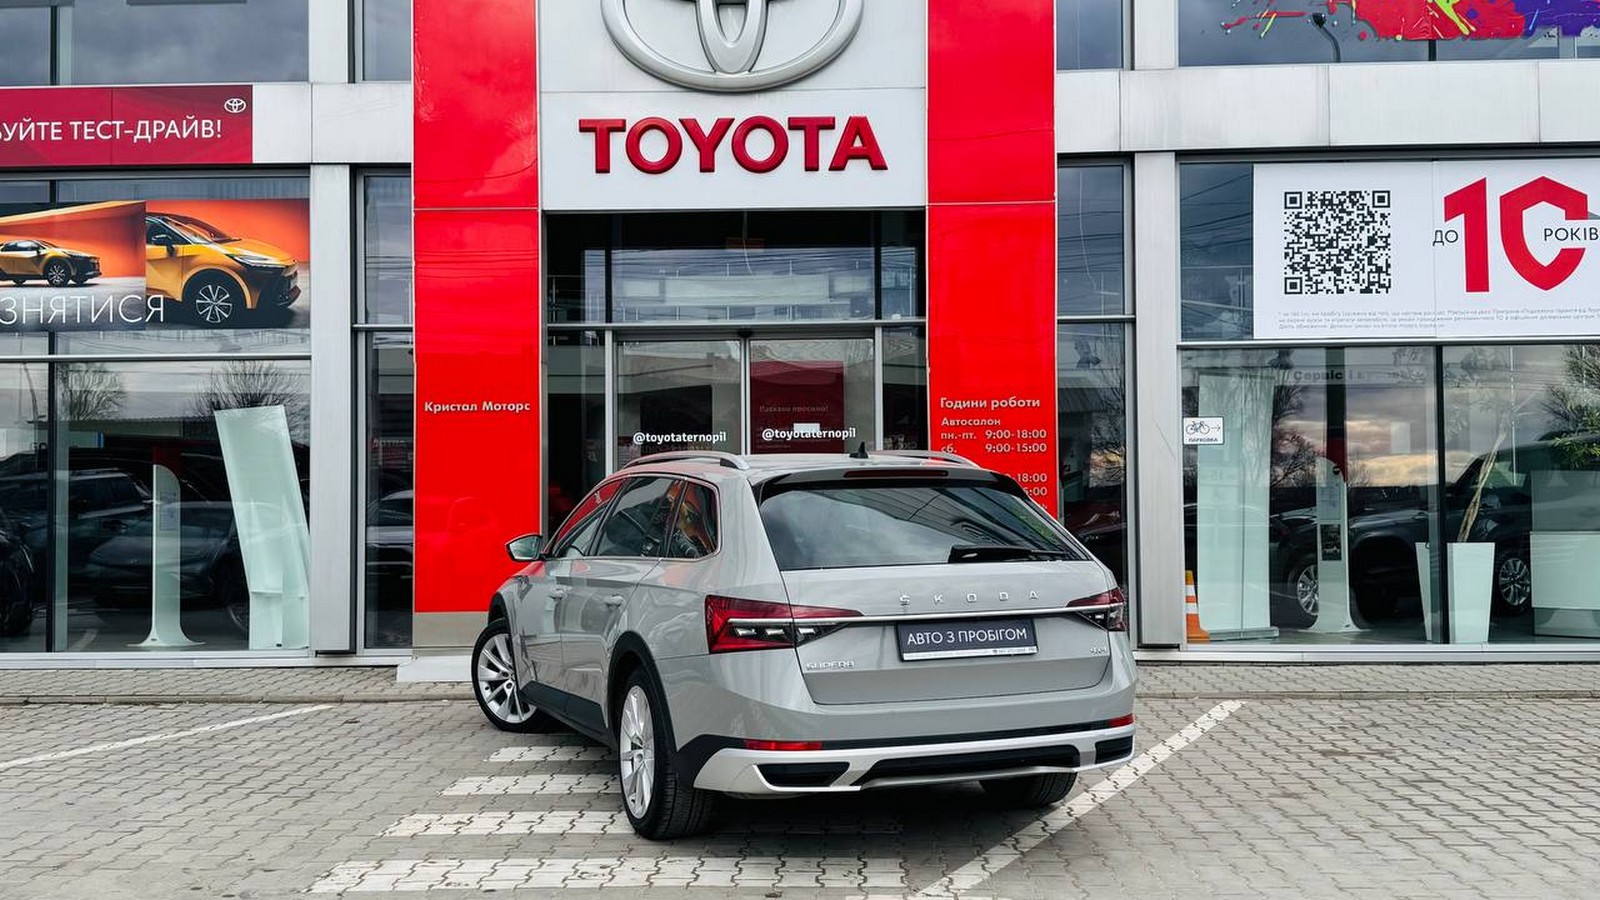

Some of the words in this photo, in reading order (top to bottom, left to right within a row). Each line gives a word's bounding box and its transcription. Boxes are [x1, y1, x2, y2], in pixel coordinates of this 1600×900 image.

[69, 114, 222, 143] ТЕСТ-ДРАЙВ!
[578, 115, 888, 174] TOYOTA
[1432, 229, 1459, 246] ДО
[1443, 175, 1589, 293] 10
[1543, 226, 1599, 242] РОКІВ
[0, 294, 165, 325] ЗНЯТИСЯ
[424, 401, 478, 414] Кристал
[482, 400, 531, 413] Моторс
[940, 397, 988, 410] Години
[991, 396, 1041, 410] роботи
[941, 417, 1001, 427] Автосалон
[633, 431, 727, 445] @toyotaternopil
[761, 427, 857, 441] @toyotaternopil
[940, 431, 977, 440] пн.-пт.
[940, 444, 957, 453] сб.
[907, 632, 943, 646] АВТО
[946, 630, 956, 643] З
[958, 627, 1028, 643] ПРОБІГОМ
